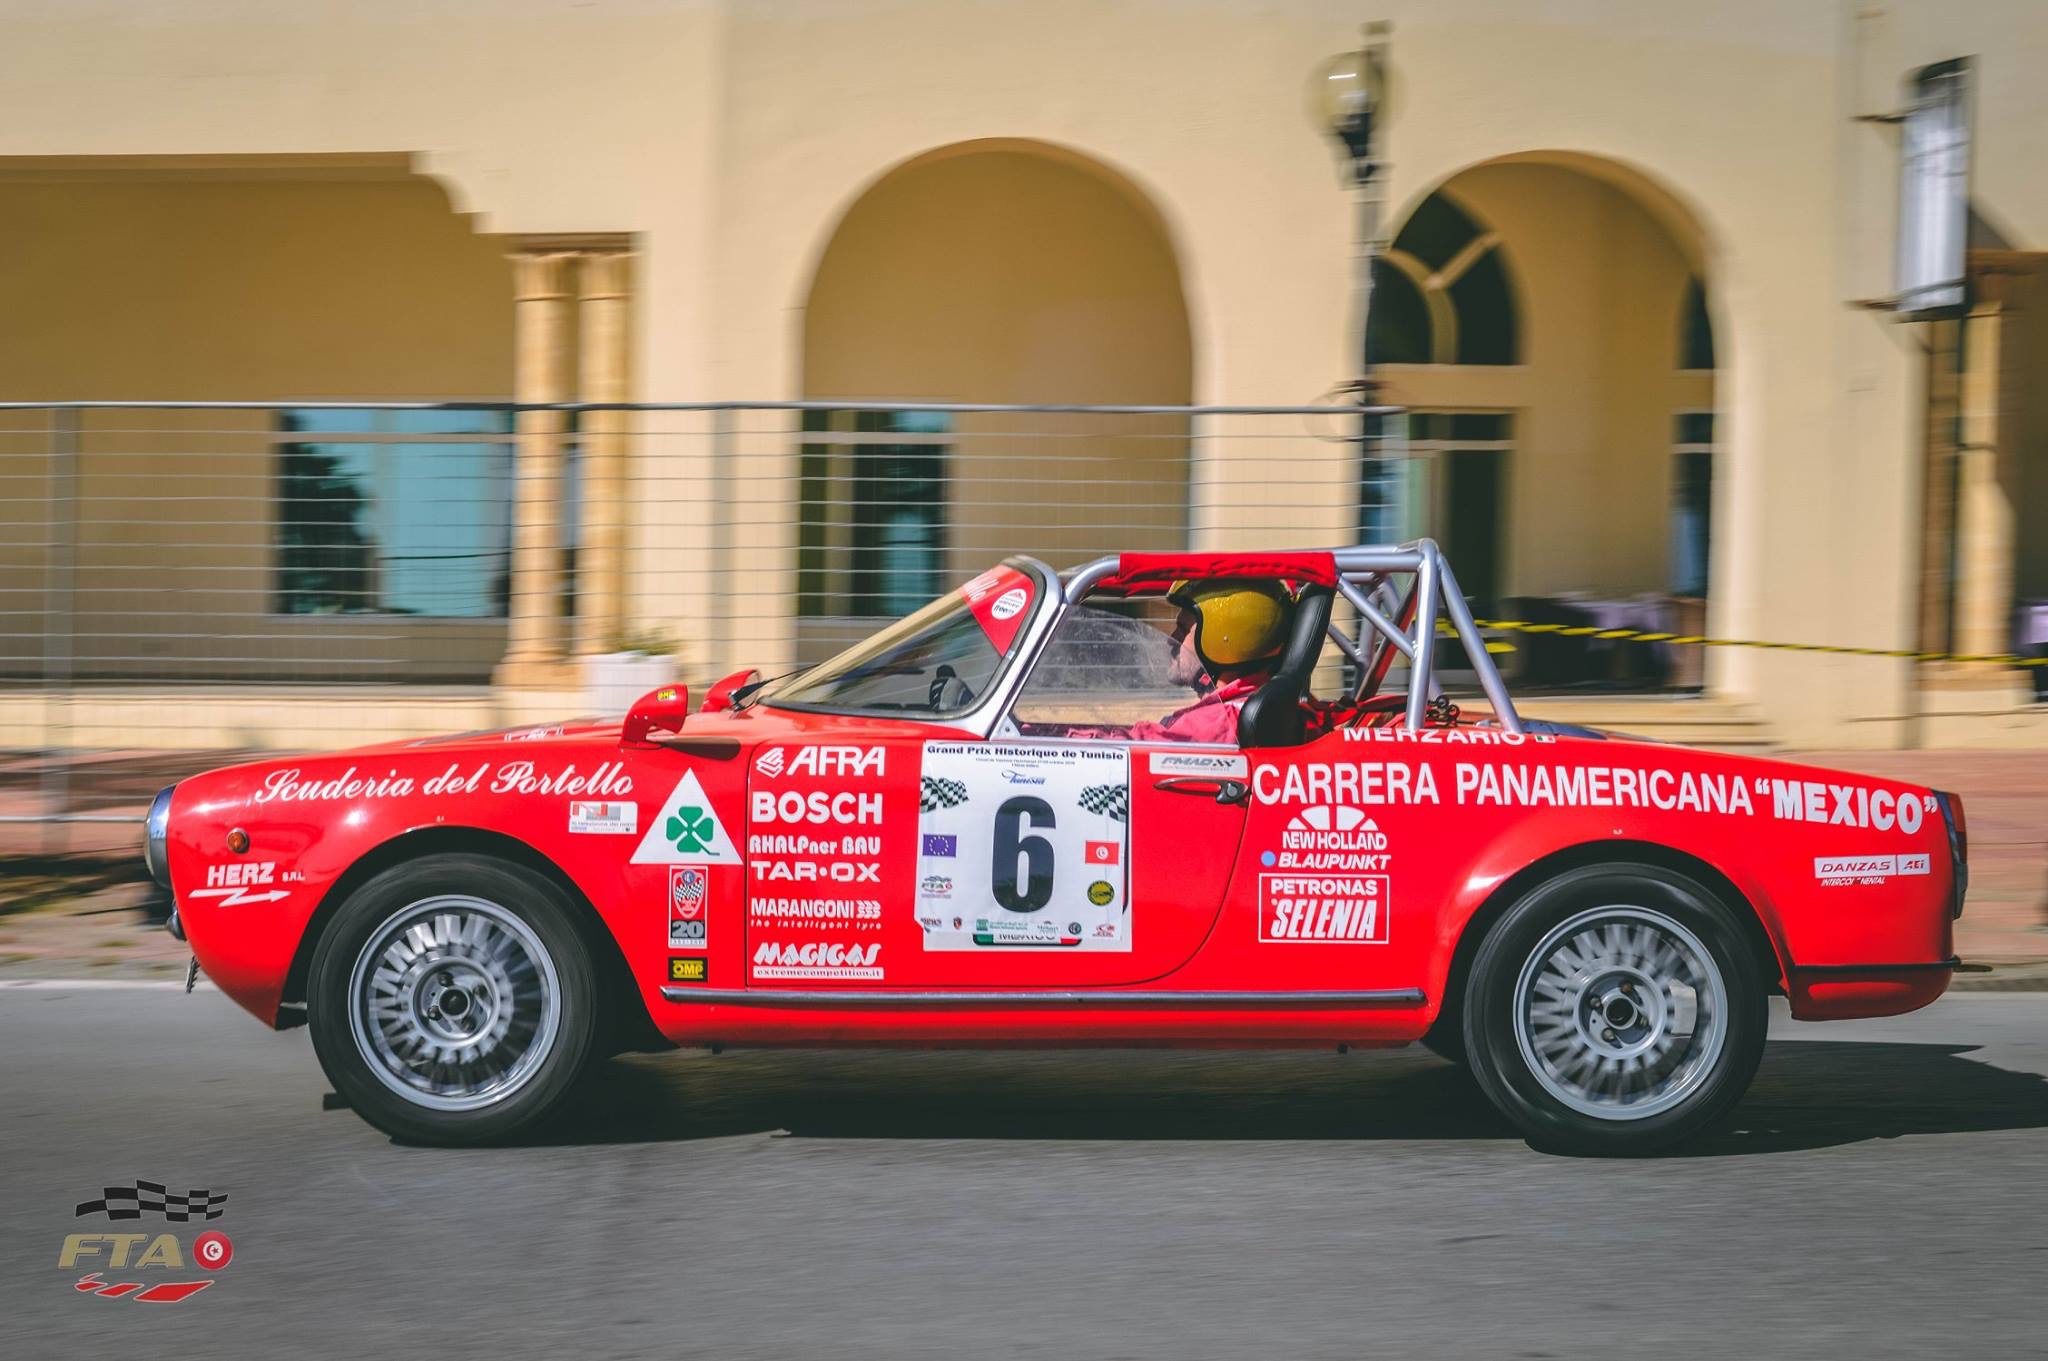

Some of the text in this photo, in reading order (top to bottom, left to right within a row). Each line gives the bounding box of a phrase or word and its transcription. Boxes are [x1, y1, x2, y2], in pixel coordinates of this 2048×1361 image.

[1343, 727, 1525, 745] MERZARIO
[786, 746, 886, 776] AFRA
[927, 745, 1124, 761] Grand Prix Historique de Tunisie
[255, 761, 634, 804] Scuderia del Portello
[1254, 762, 1440, 805] CARRERA
[1455, 763, 1754, 816] PANAMERICANA
[751, 791, 883, 825] BOSCH
[841, 835, 881, 855] BAU
[1282, 831, 1387, 850] NEW HOLLAND
[992, 795, 1056, 913] 6
[1278, 852, 1392, 870] BLAUPUNKT
[207, 861, 276, 888] HERZ
[1820, 860, 1891, 873] DANZAS
[1270, 878, 1379, 896] PETRONAS
[750, 897, 855, 919] MARANGONI
[750, 919, 771, 928] the
[855, 921, 882, 931] tyre
[1270, 898, 1378, 939] SELENIA
[672, 920, 705, 938] 20
[673, 963, 704, 976] OMP
[756, 967, 881, 977] extremecompetition.it
